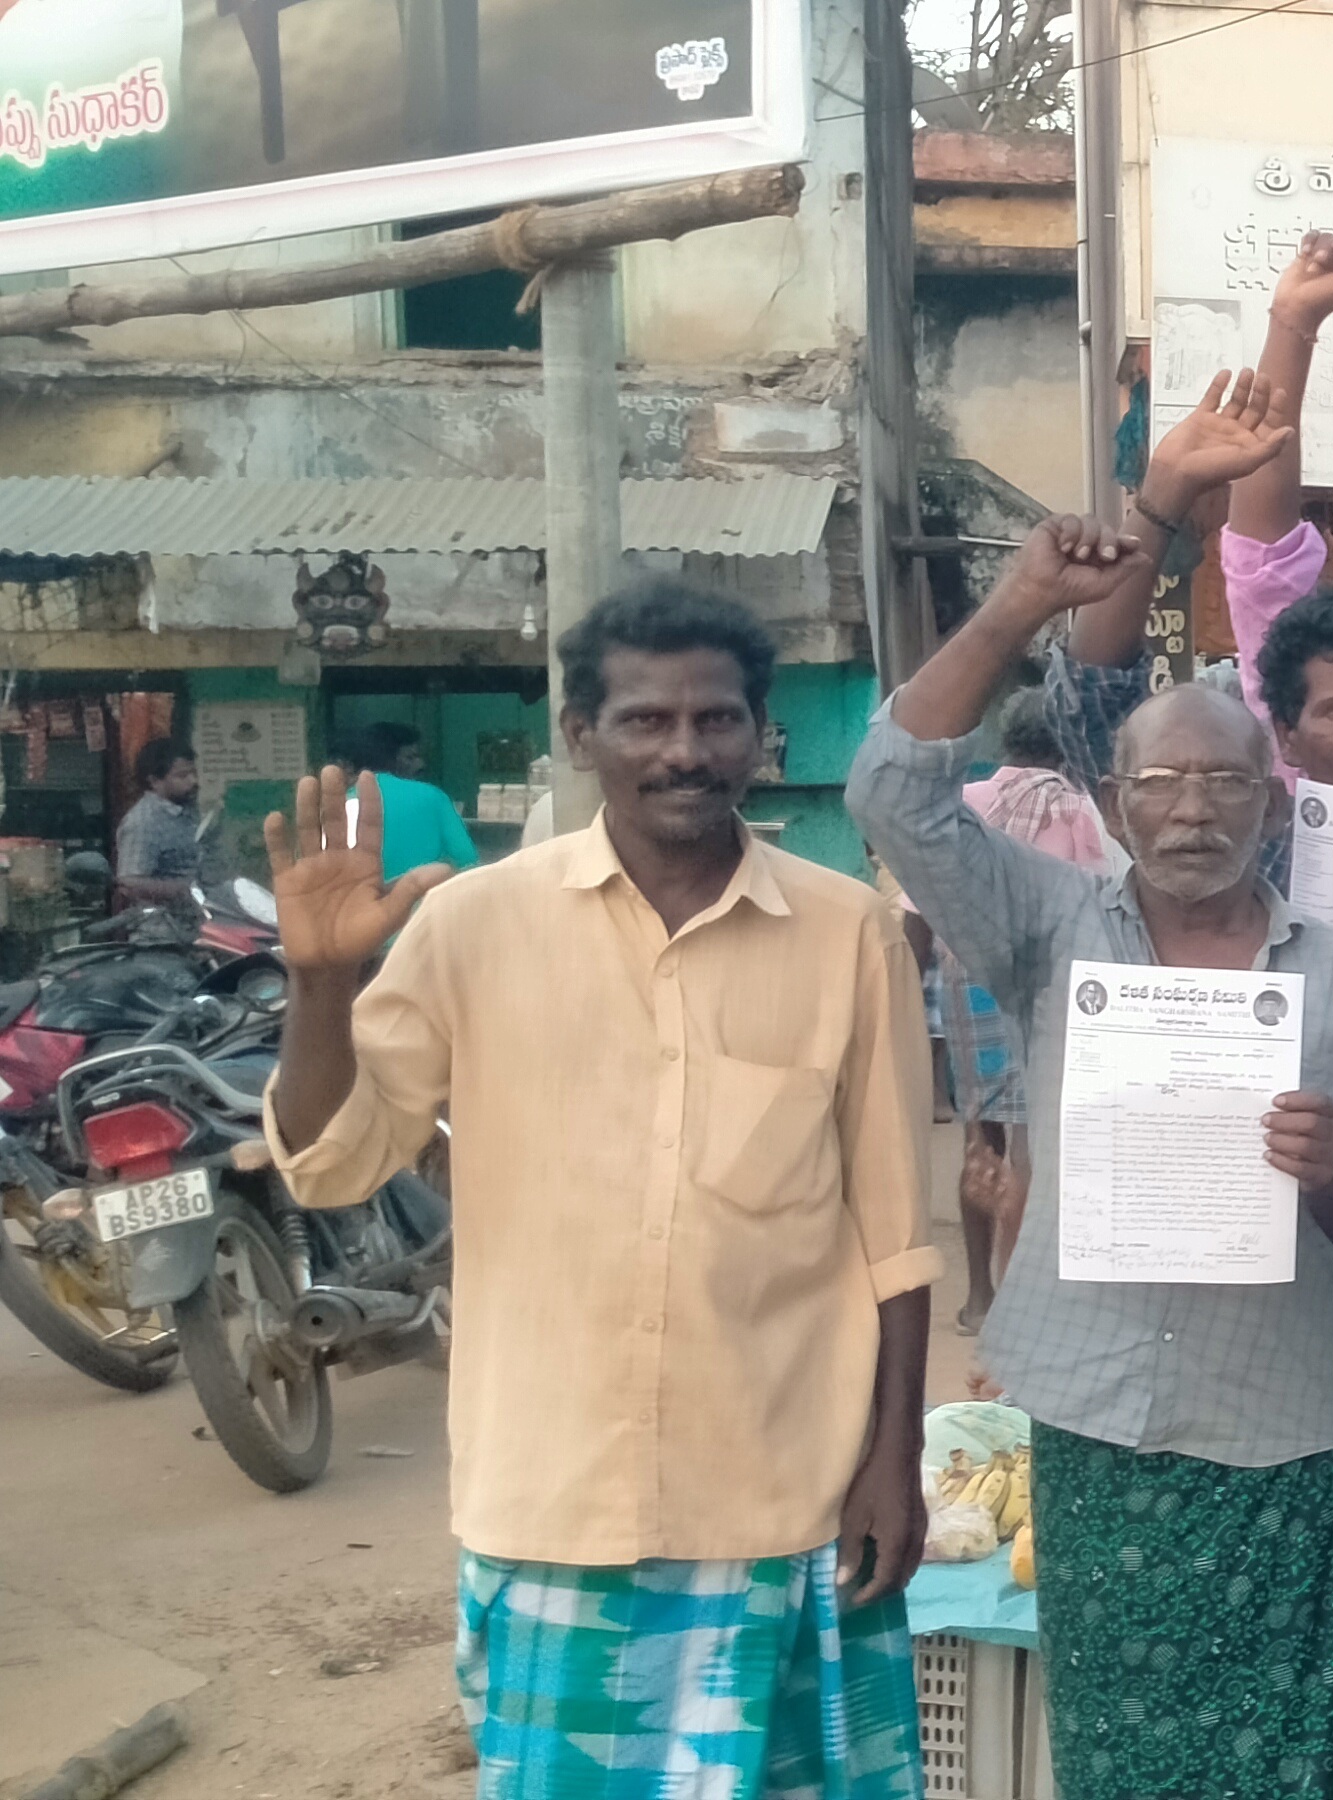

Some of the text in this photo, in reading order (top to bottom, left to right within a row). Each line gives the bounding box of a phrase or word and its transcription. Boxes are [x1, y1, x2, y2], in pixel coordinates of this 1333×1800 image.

[48, 66, 164, 143] సుధాకర్
[1254, 157, 1298, 197] శ్రీ
[109, 1192, 208, 1238] BS9380
[125, 1176, 188, 1212] AP26
